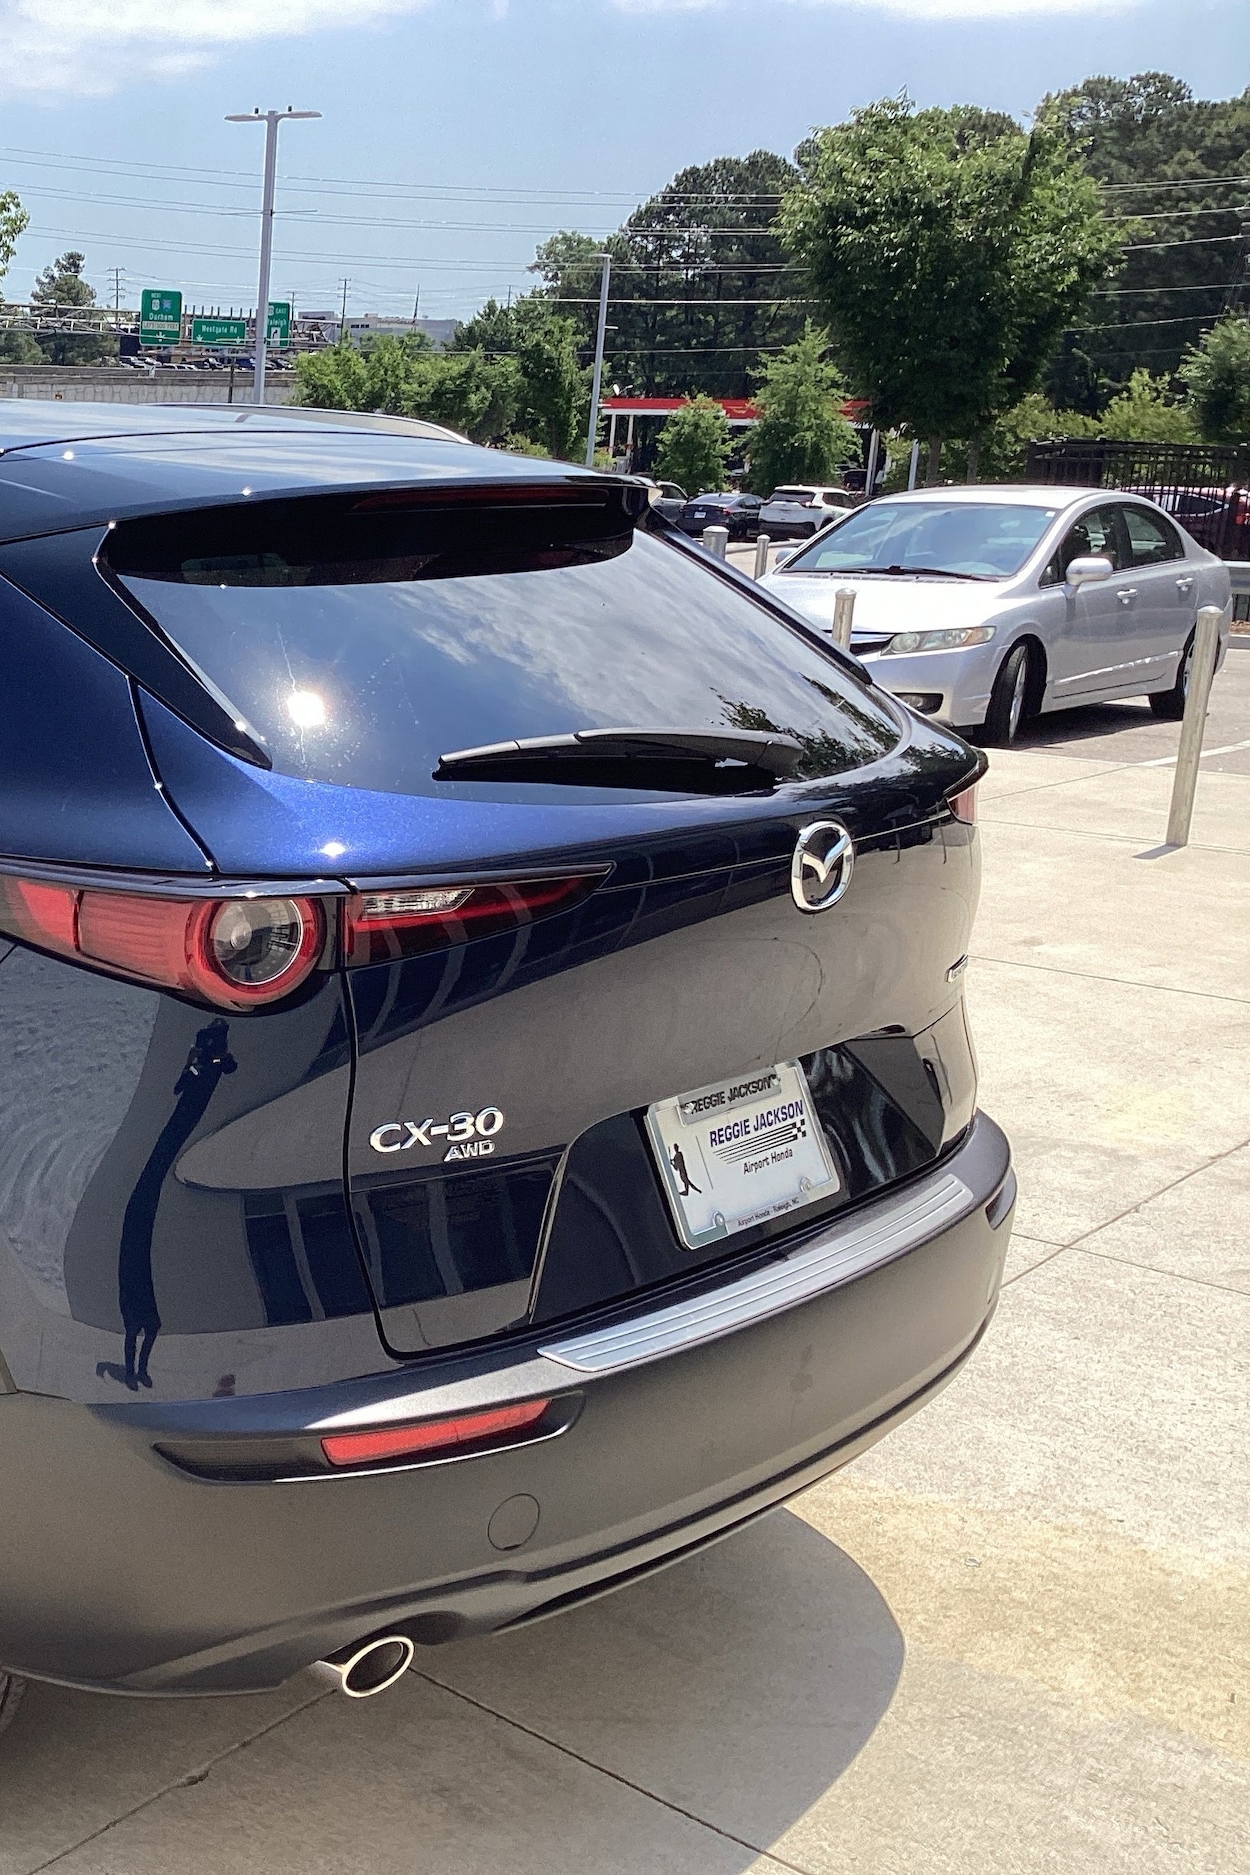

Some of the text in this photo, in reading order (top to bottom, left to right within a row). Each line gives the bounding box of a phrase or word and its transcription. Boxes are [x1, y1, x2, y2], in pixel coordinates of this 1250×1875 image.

[149, 312, 174, 321] Durham
[267, 318, 287, 328] aleigh
[201, 325, 238, 334] Westgate Rd
[689, 1074, 773, 1115] REGGIE JACKSON
[369, 1106, 504, 1153] CX-30
[709, 1100, 804, 1148] REGGIE JACKSON
[443, 1139, 496, 1162] AWD
[743, 1147, 793, 1175] Airport Honda
